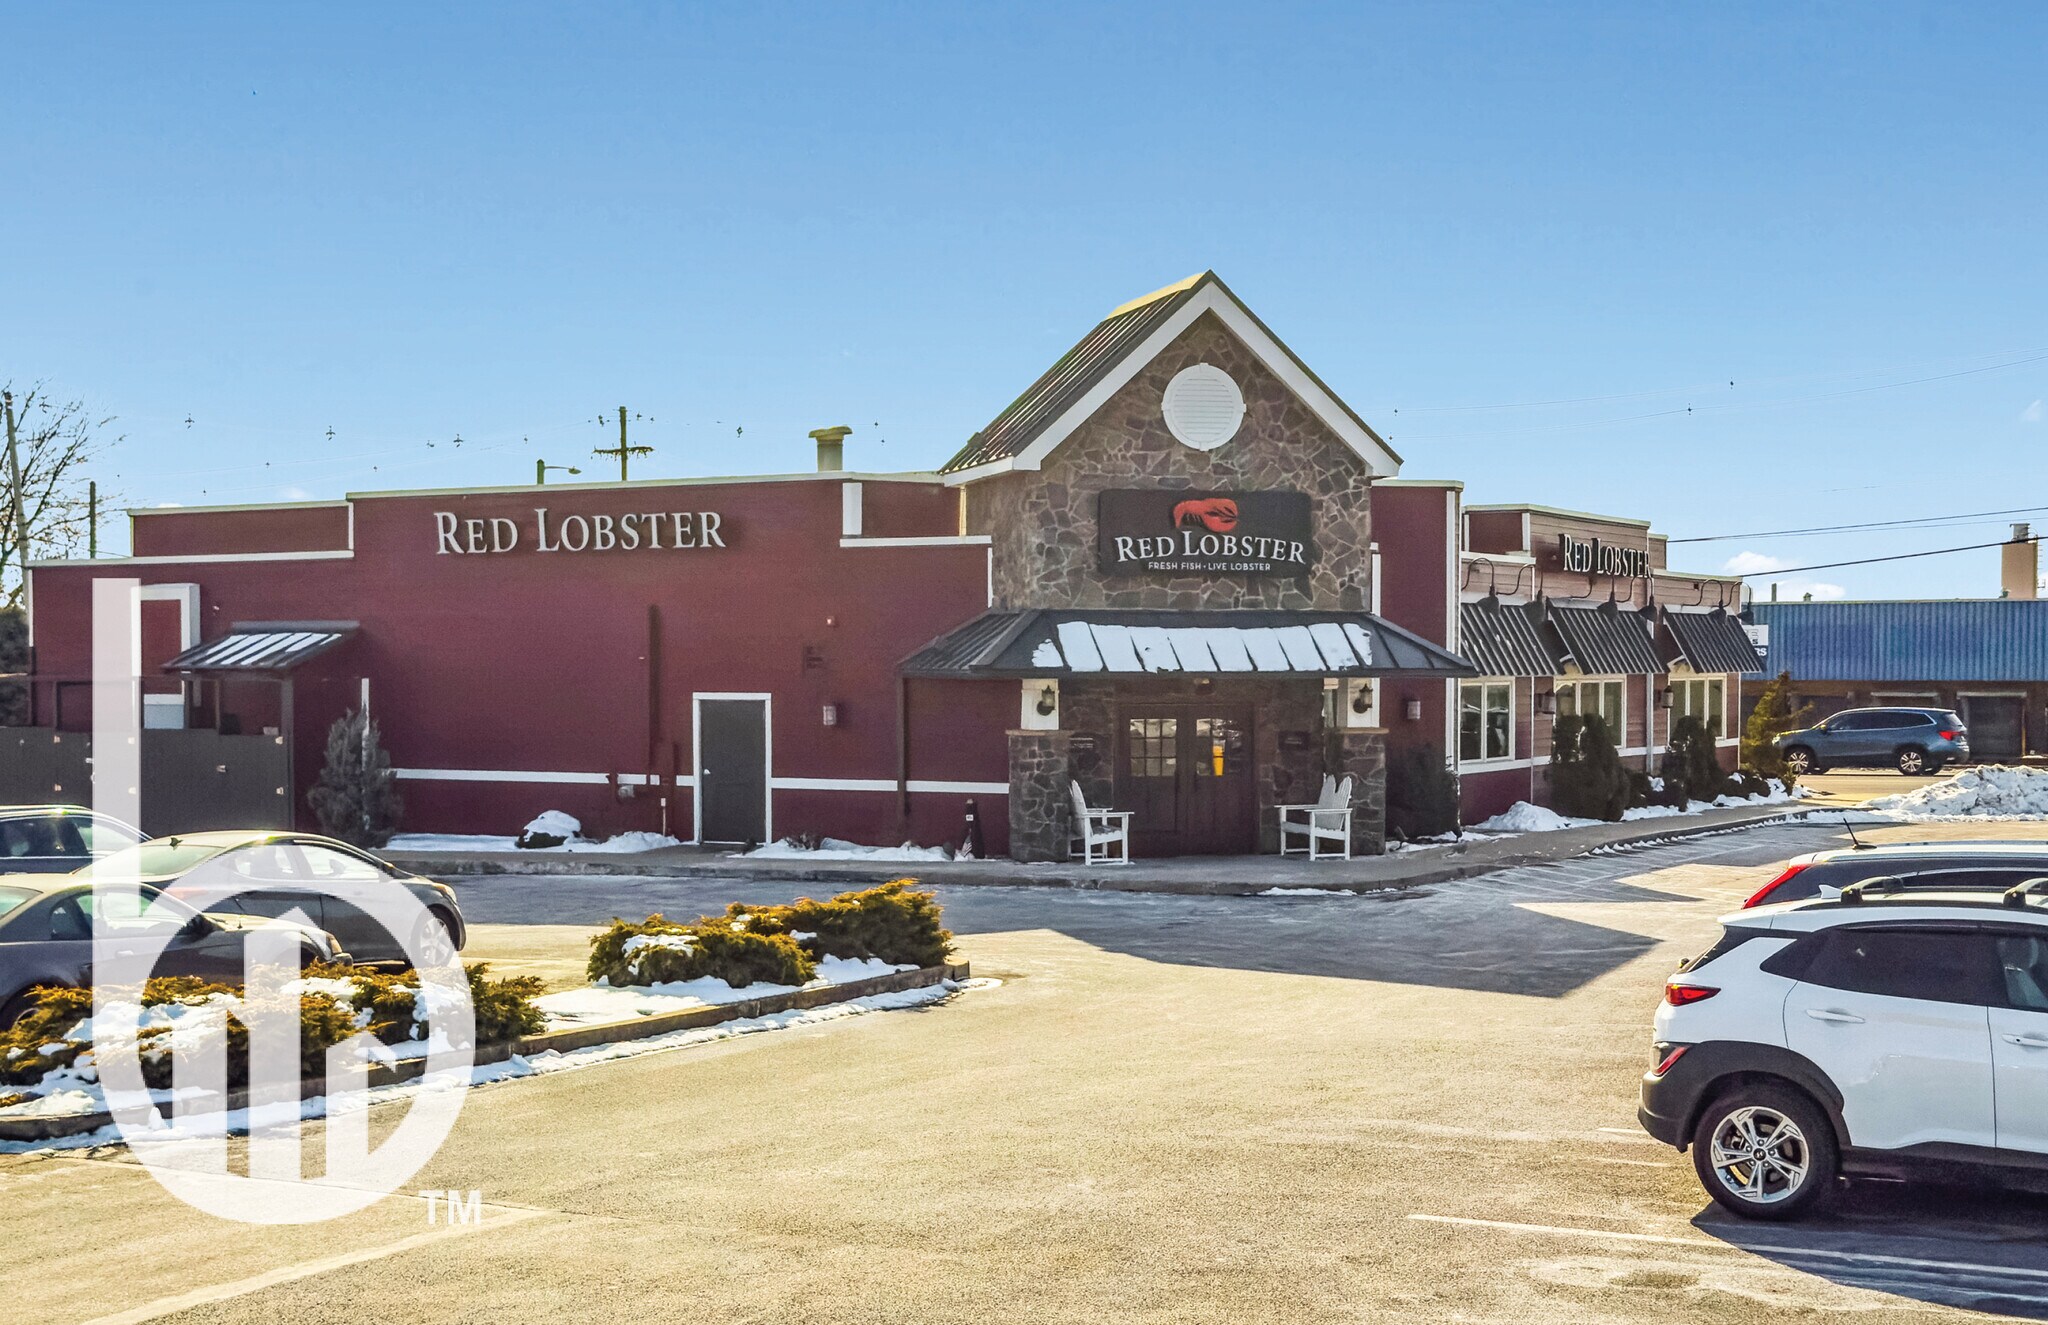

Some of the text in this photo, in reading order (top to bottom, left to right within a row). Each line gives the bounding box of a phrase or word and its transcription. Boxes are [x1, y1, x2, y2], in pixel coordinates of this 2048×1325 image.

[433, 507, 726, 554] RED LOBSTER
[1114, 530, 1307, 565] RED LOBSTER
[1148, 561, 1271, 571] FRESH FISH LIVE LOBSTER
[1563, 533, 1652, 579] RED LOBSTER
